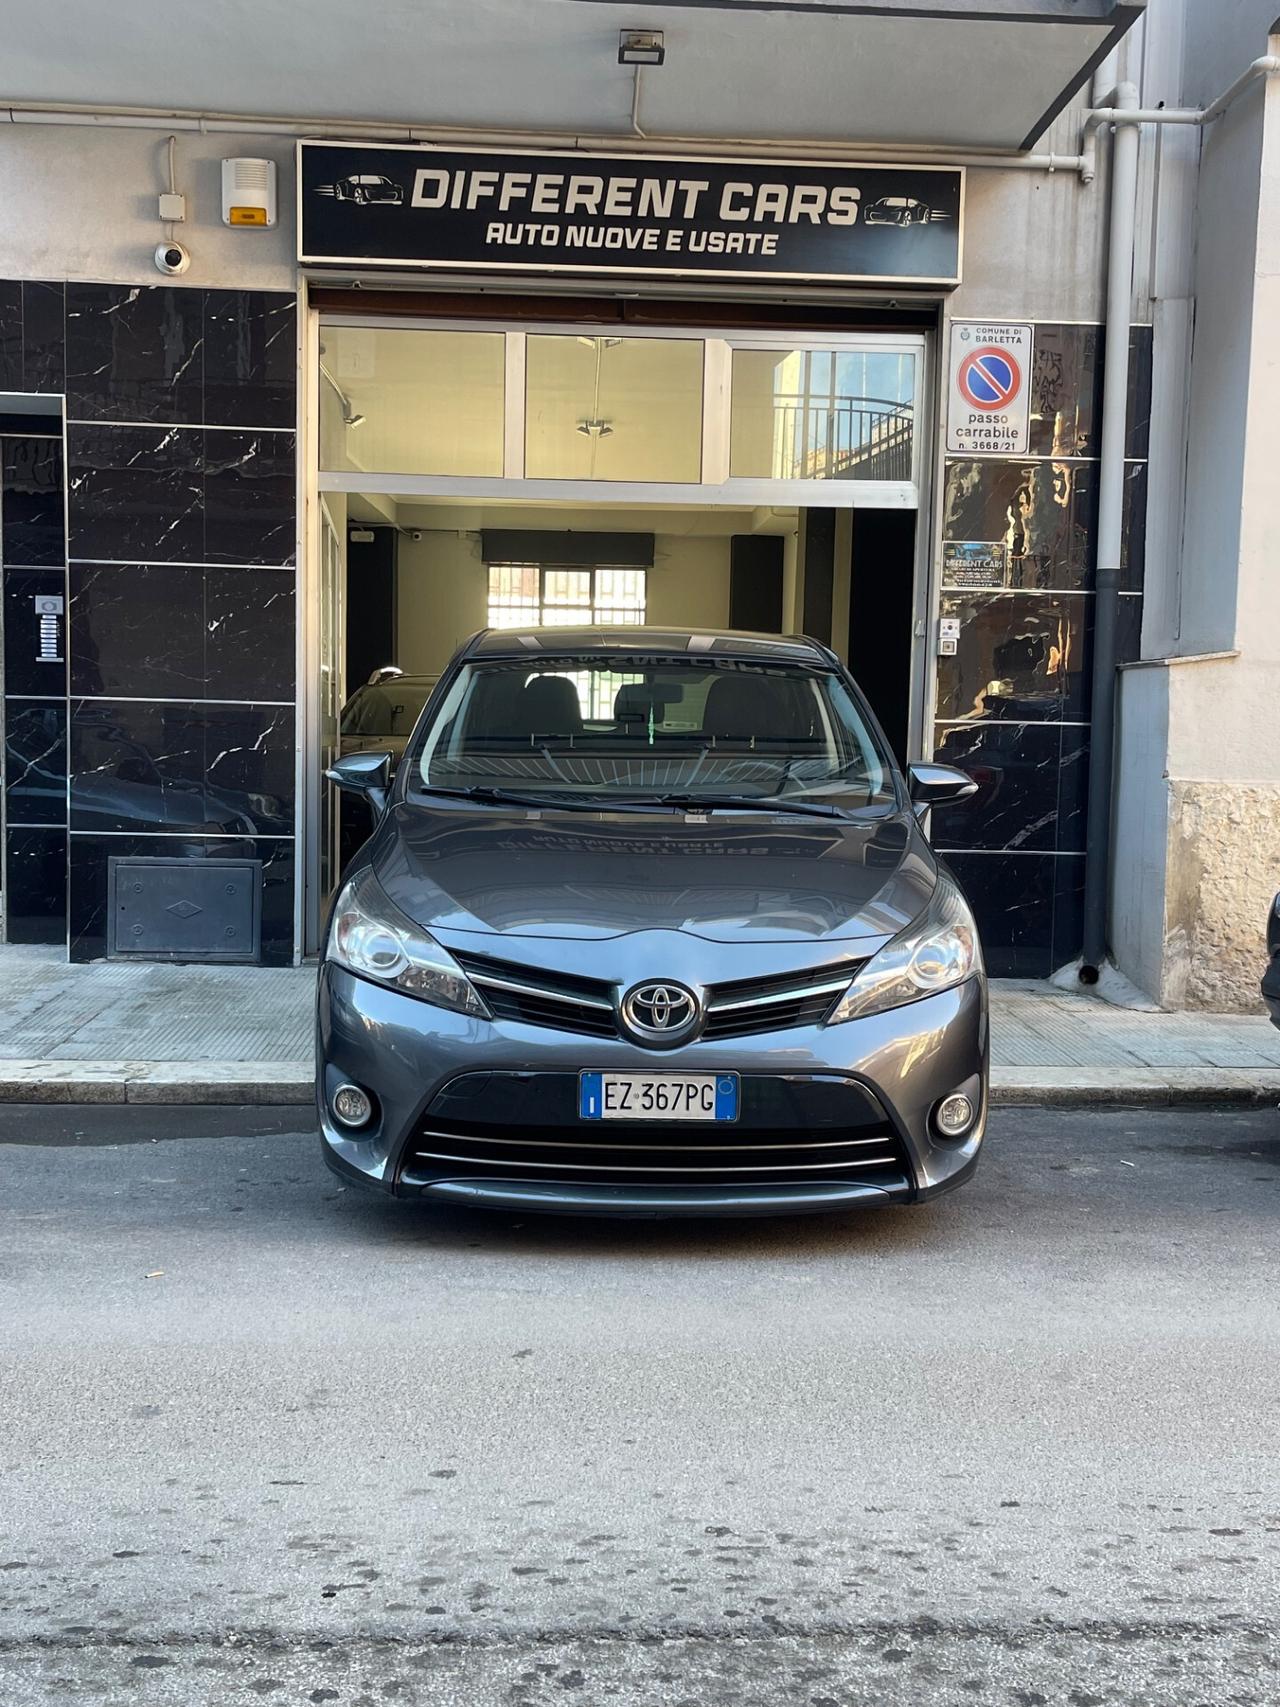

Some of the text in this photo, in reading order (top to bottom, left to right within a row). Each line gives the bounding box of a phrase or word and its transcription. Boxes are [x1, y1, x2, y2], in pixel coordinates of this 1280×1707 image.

[410, 168, 861, 226] DIFFERENT CARS
[485, 222, 779, 255] AUTO NUOVE E USATE
[976, 327, 1010, 335] COMUNE
[975, 335, 1022, 344] BARLETTA
[968, 414, 1009, 425] passo
[955, 426, 1019, 439] carrabile
[972, 441, 1015, 451] 3668/21
[604, 1082, 633, 1111] EZ
[641, 1083, 714, 1112] 367PG
